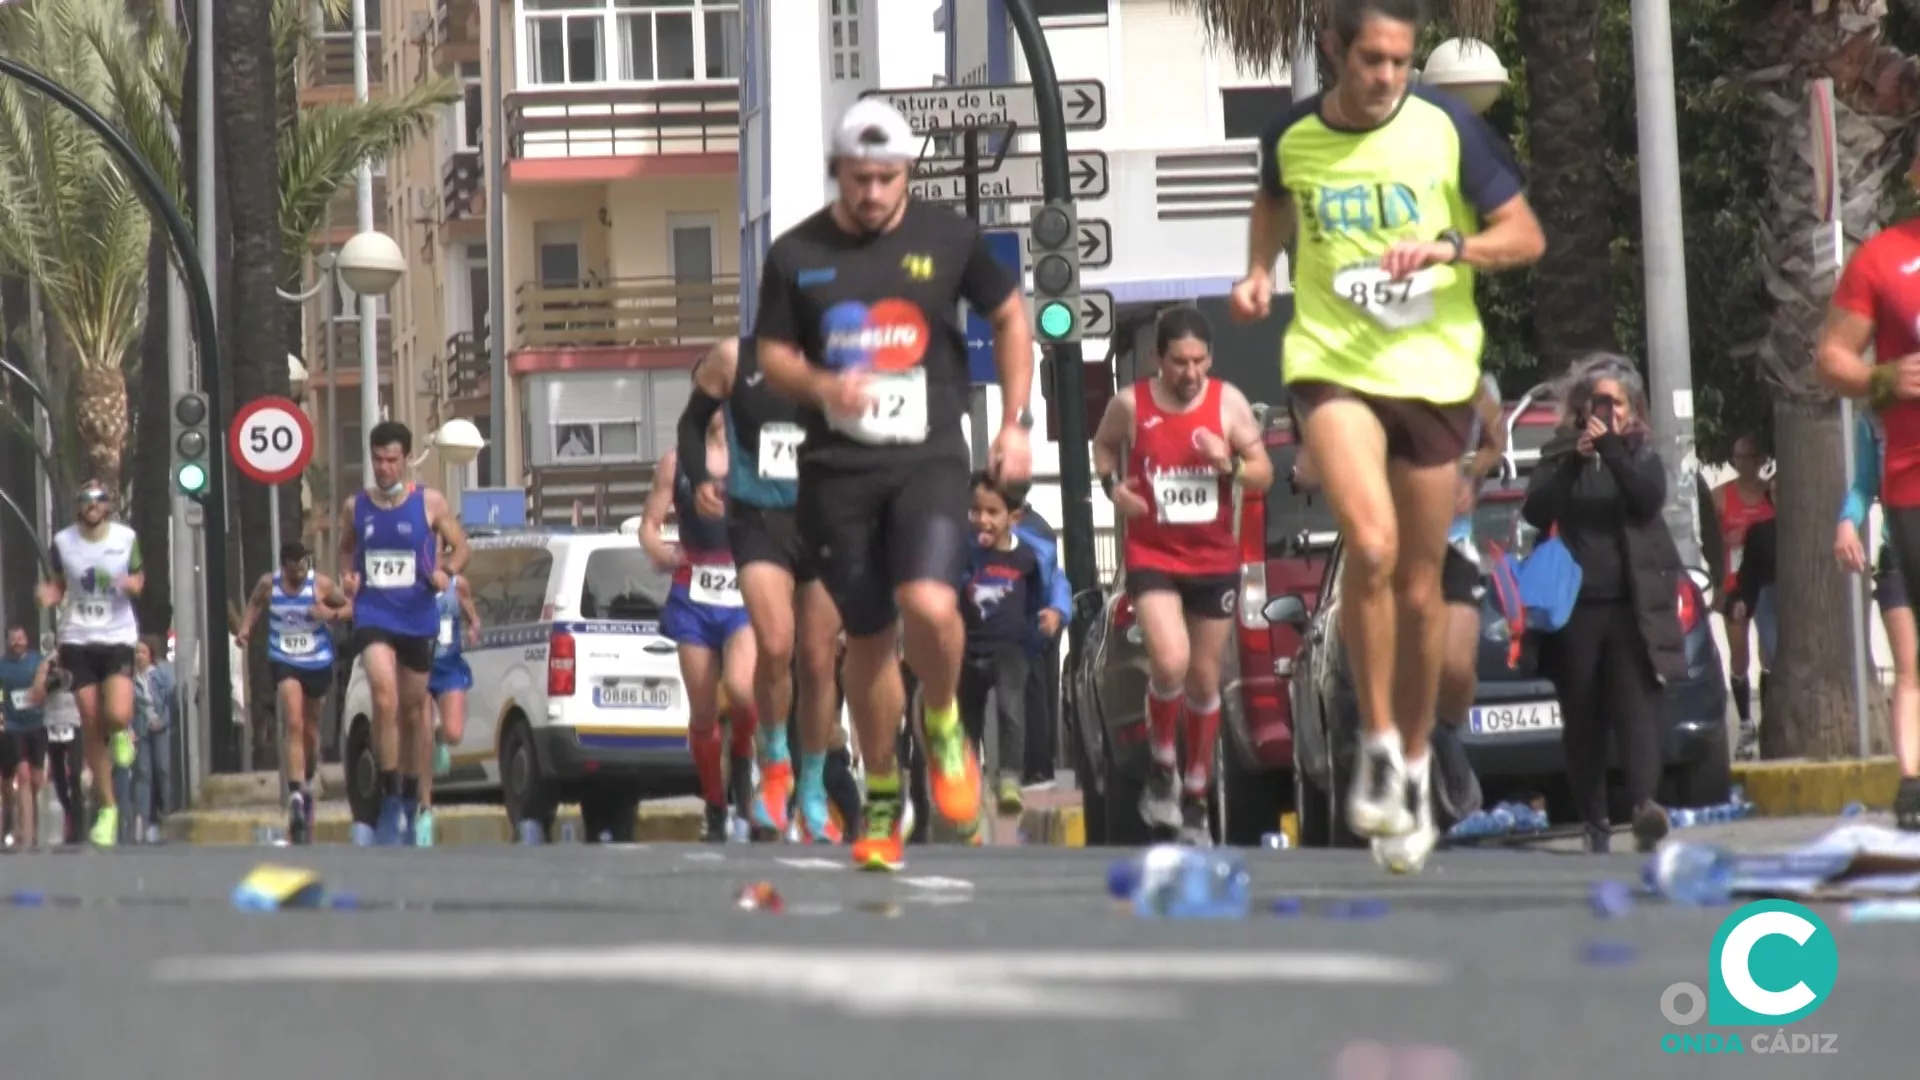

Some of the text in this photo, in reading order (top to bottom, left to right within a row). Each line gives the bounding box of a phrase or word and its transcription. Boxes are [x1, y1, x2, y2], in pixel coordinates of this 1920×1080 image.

[957, 90, 980, 108] de
[989, 90, 1006, 107] la
[951, 107, 1007, 129] Local
[953, 175, 1012, 197] Lcal
[1351, 277, 1415, 308] 857
[250, 425, 293, 453] 50
[1162, 486, 1208, 507] 968
[371, 560, 407, 577] 757
[1486, 704, 1542, 731] 0944
